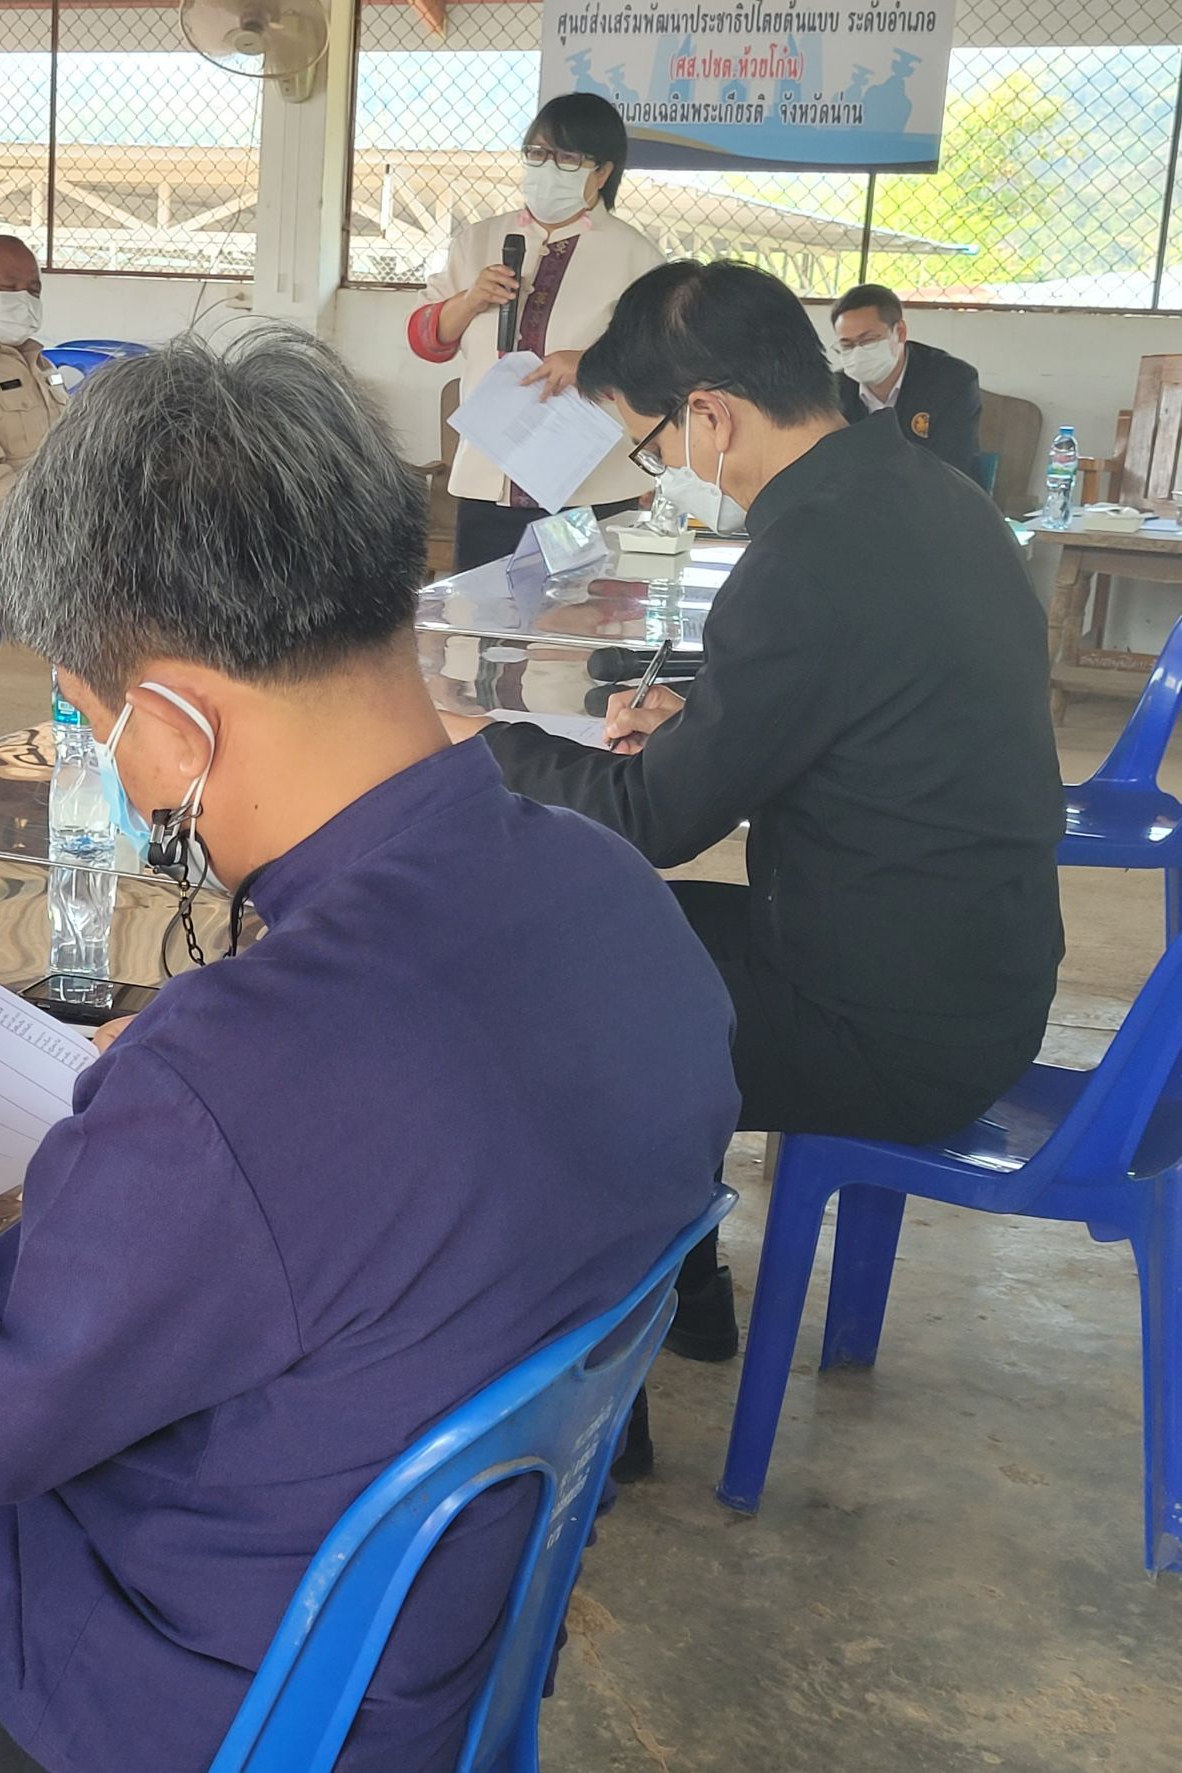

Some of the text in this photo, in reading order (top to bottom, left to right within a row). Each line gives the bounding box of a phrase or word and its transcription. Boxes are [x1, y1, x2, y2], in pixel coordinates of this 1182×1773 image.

[847, 0, 937, 33] ระดับอำเภอ
[613, 92, 864, 126] ำเภอเฉลิมพระเกียรติ จังหวัดน่าน
